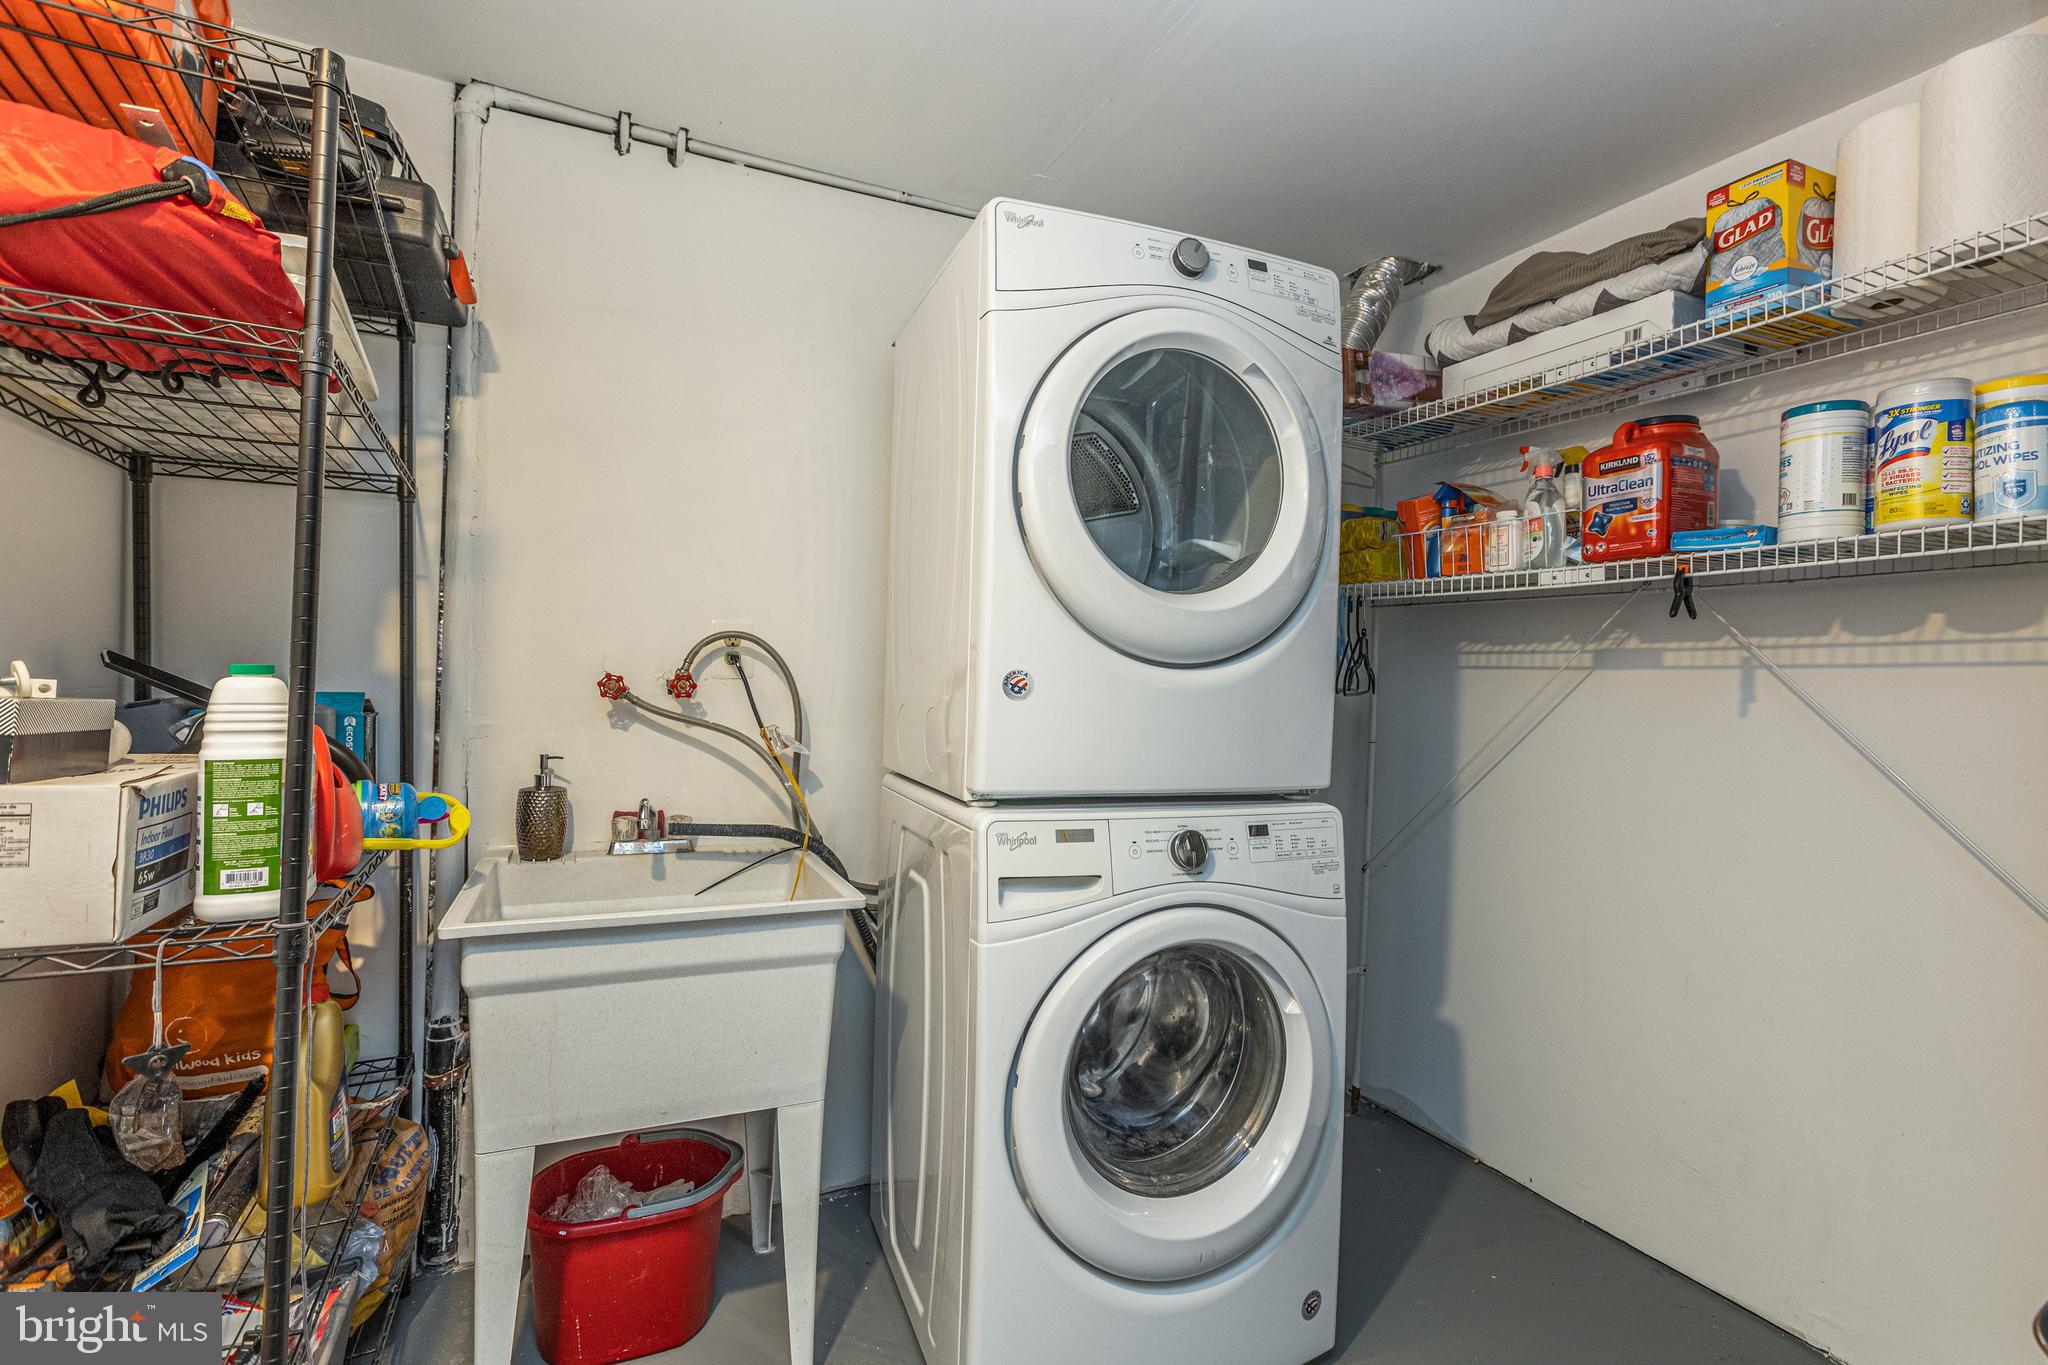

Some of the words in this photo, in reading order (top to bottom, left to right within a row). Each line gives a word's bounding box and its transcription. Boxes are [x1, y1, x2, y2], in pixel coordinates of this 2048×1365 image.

[1004, 212, 1044, 229] Whirlpool
[1718, 211, 1773, 249] GLAD
[1806, 219, 1834, 244] GLA
[1901, 403, 1942, 415] STRONGER
[1879, 420, 1932, 458] Lysol
[1600, 456, 1639, 471] KIRKLAND
[1993, 450, 2039, 466] WIPES
[1881, 469, 1897, 478] KILLS
[1889, 471, 1921, 481] VIRUSES
[1588, 477, 1654, 498] UltraClean
[1881, 483, 1922, 494] DISINFECTING
[1885, 477, 1921, 487] BACTERIA
[138, 787, 188, 821] PHILIPS
[141, 830, 162, 846] Indoor
[997, 834, 1037, 849] Whirlpool
[138, 848, 155, 864] BR30
[224, 1050, 262, 1066] kids
